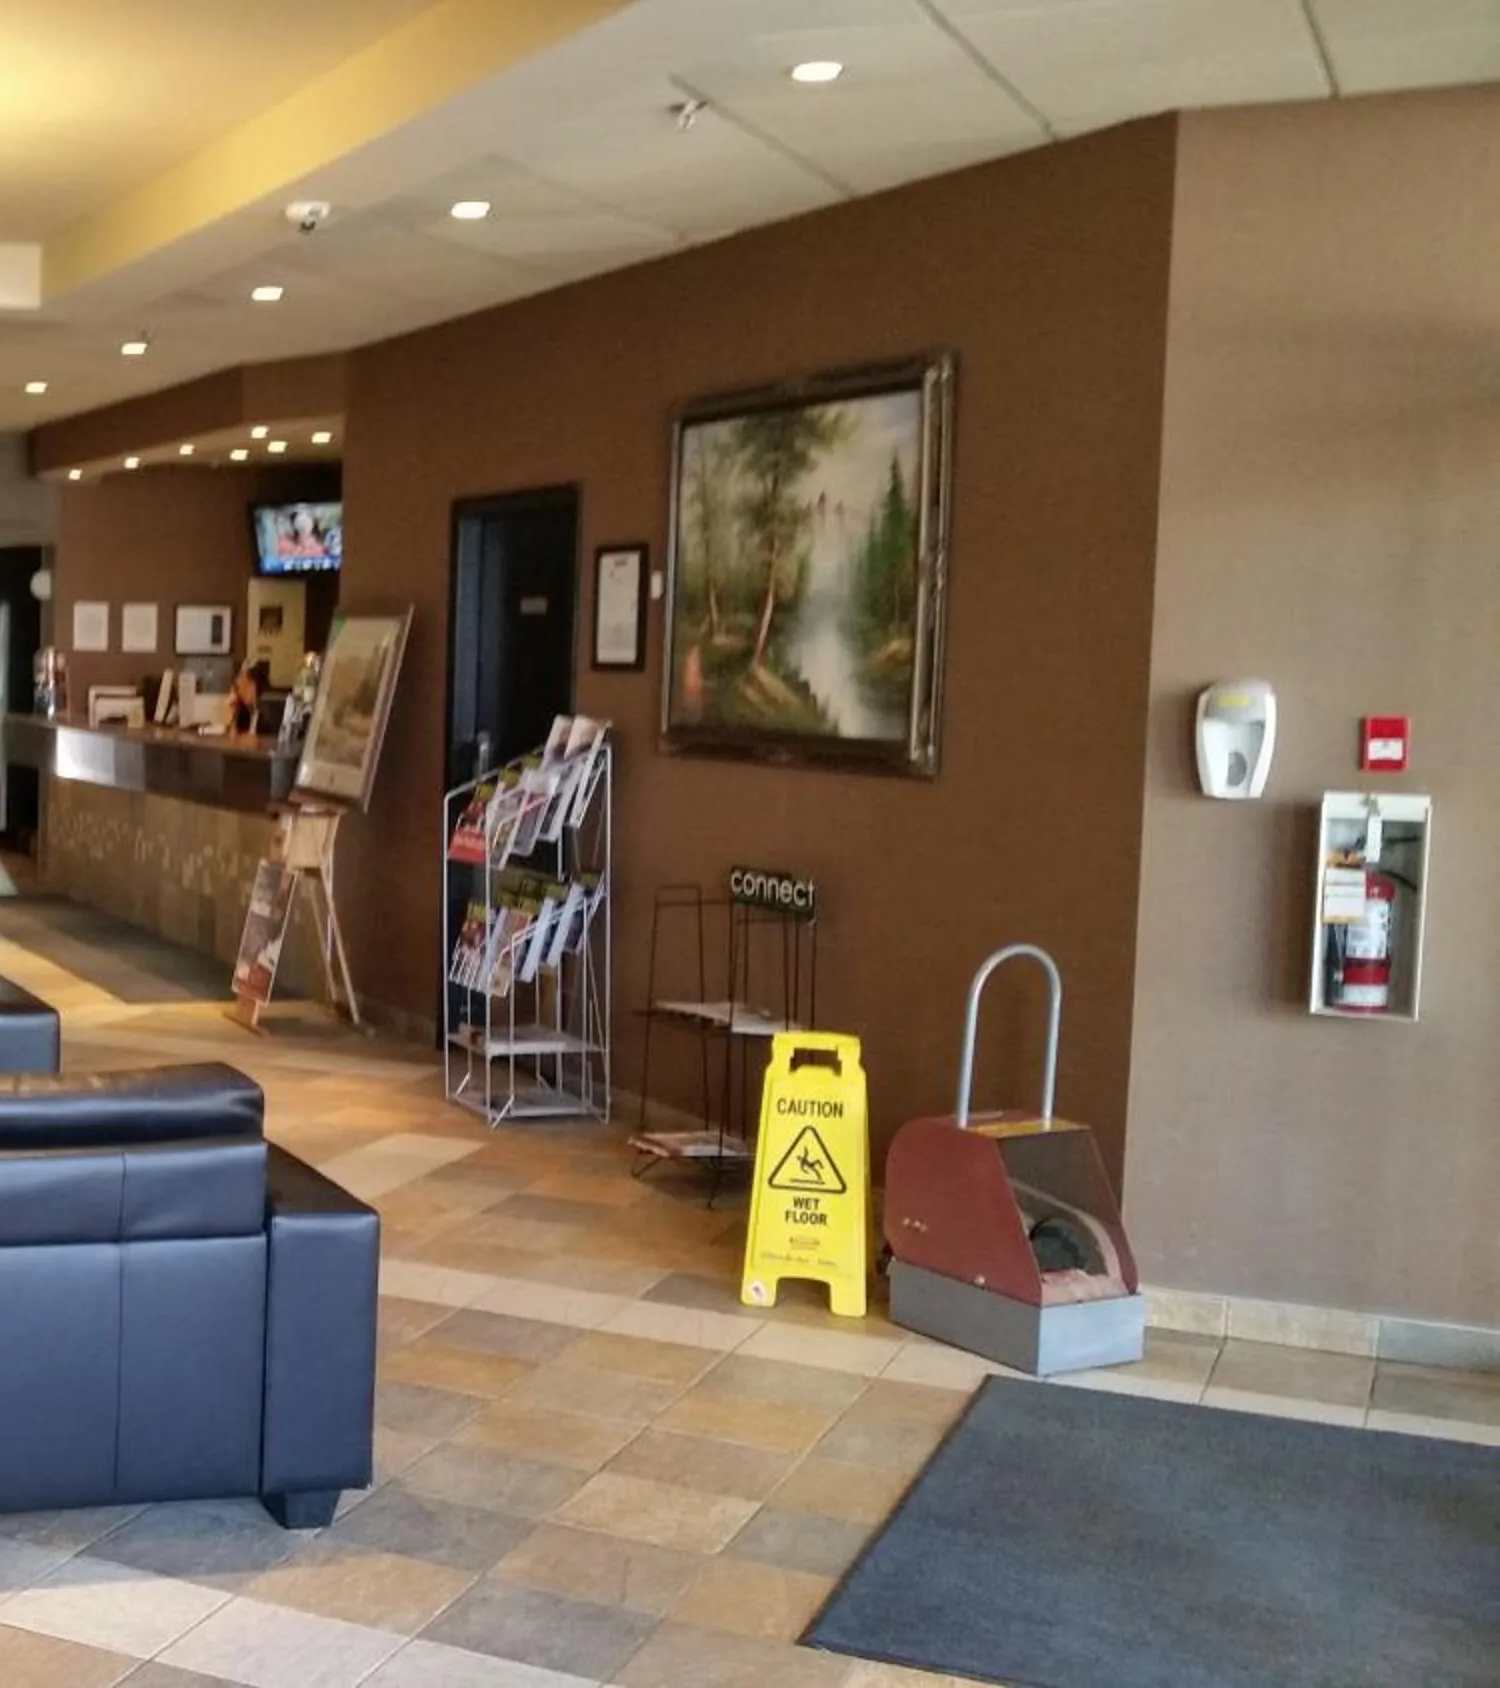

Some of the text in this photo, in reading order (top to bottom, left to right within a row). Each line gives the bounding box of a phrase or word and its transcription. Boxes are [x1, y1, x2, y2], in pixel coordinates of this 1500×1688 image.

[731, 870, 814, 907] connect
[777, 1098, 843, 1118] CAUTION
[793, 1196, 820, 1210] WET
[785, 1210, 827, 1225] FLOOR
